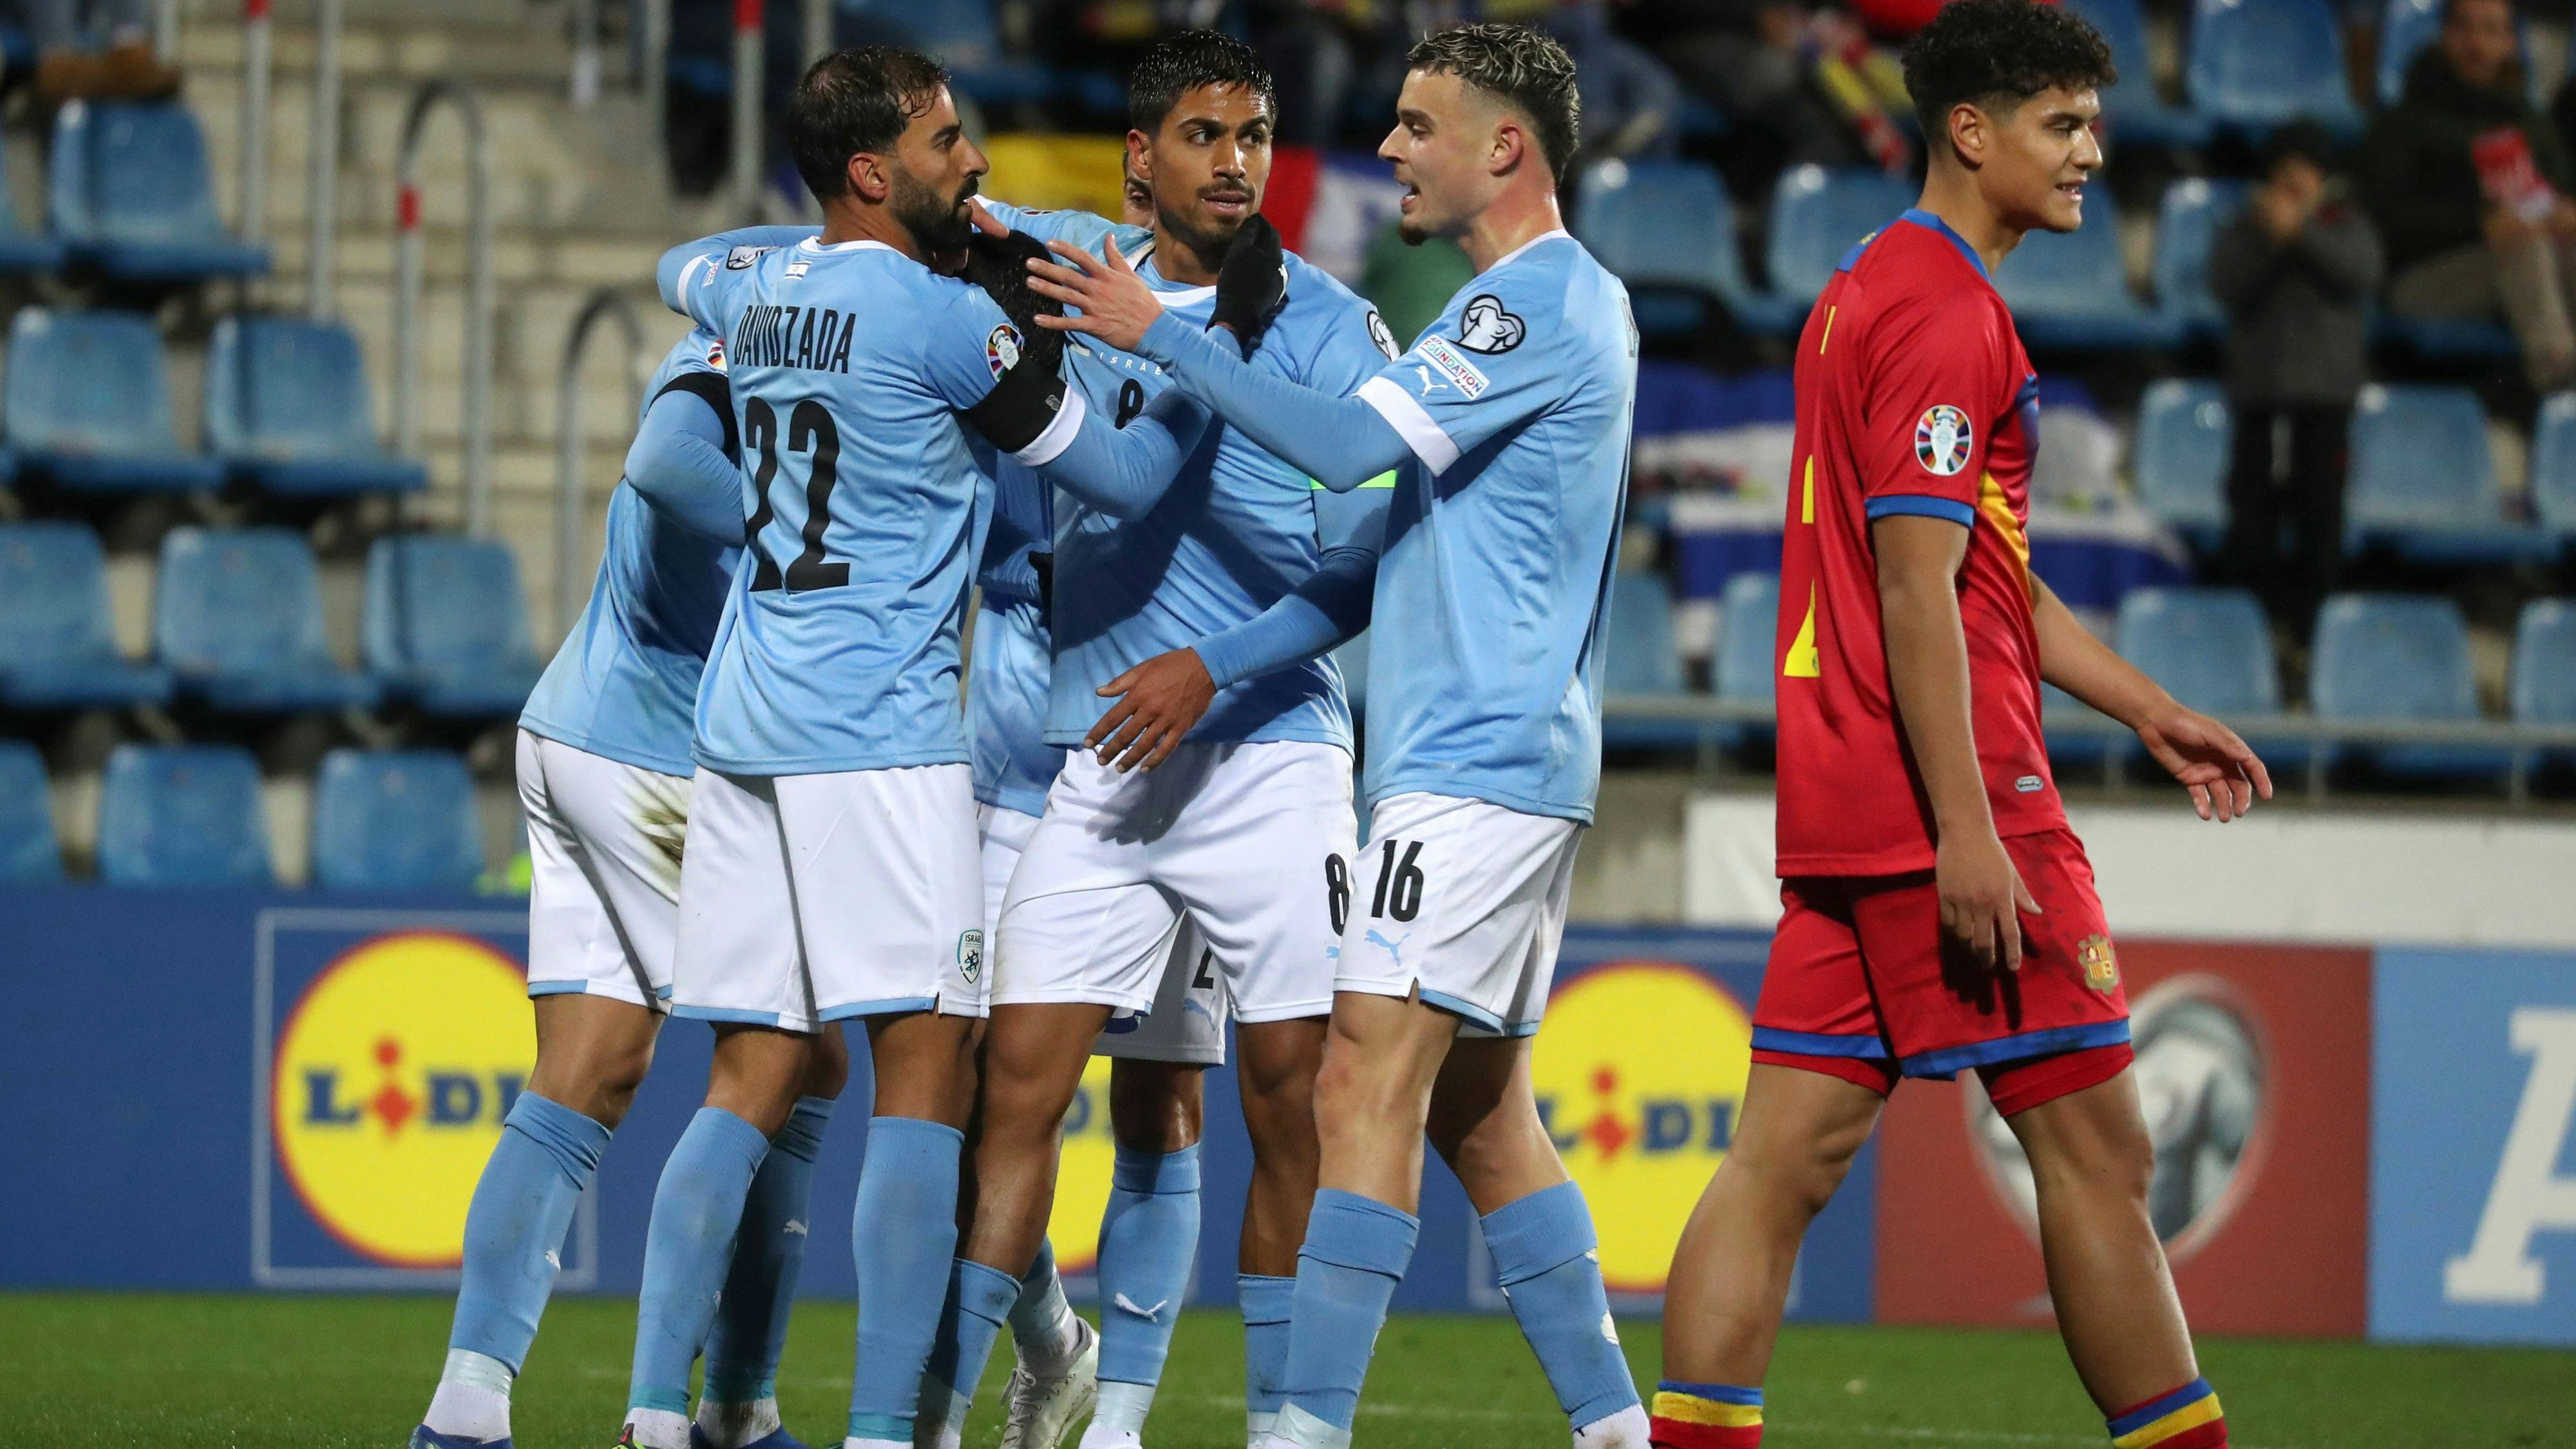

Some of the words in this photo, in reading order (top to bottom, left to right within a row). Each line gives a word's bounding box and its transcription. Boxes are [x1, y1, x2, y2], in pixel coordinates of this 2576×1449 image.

[734, 305, 856, 374] DAVIDZADA
[1100, 352, 1162, 375] ISRAE
[1422, 340, 1482, 392] FOUNDATION
[745, 396, 849, 593] 22
[1325, 853, 1350, 936] 8
[1371, 839, 1424, 922] 16
